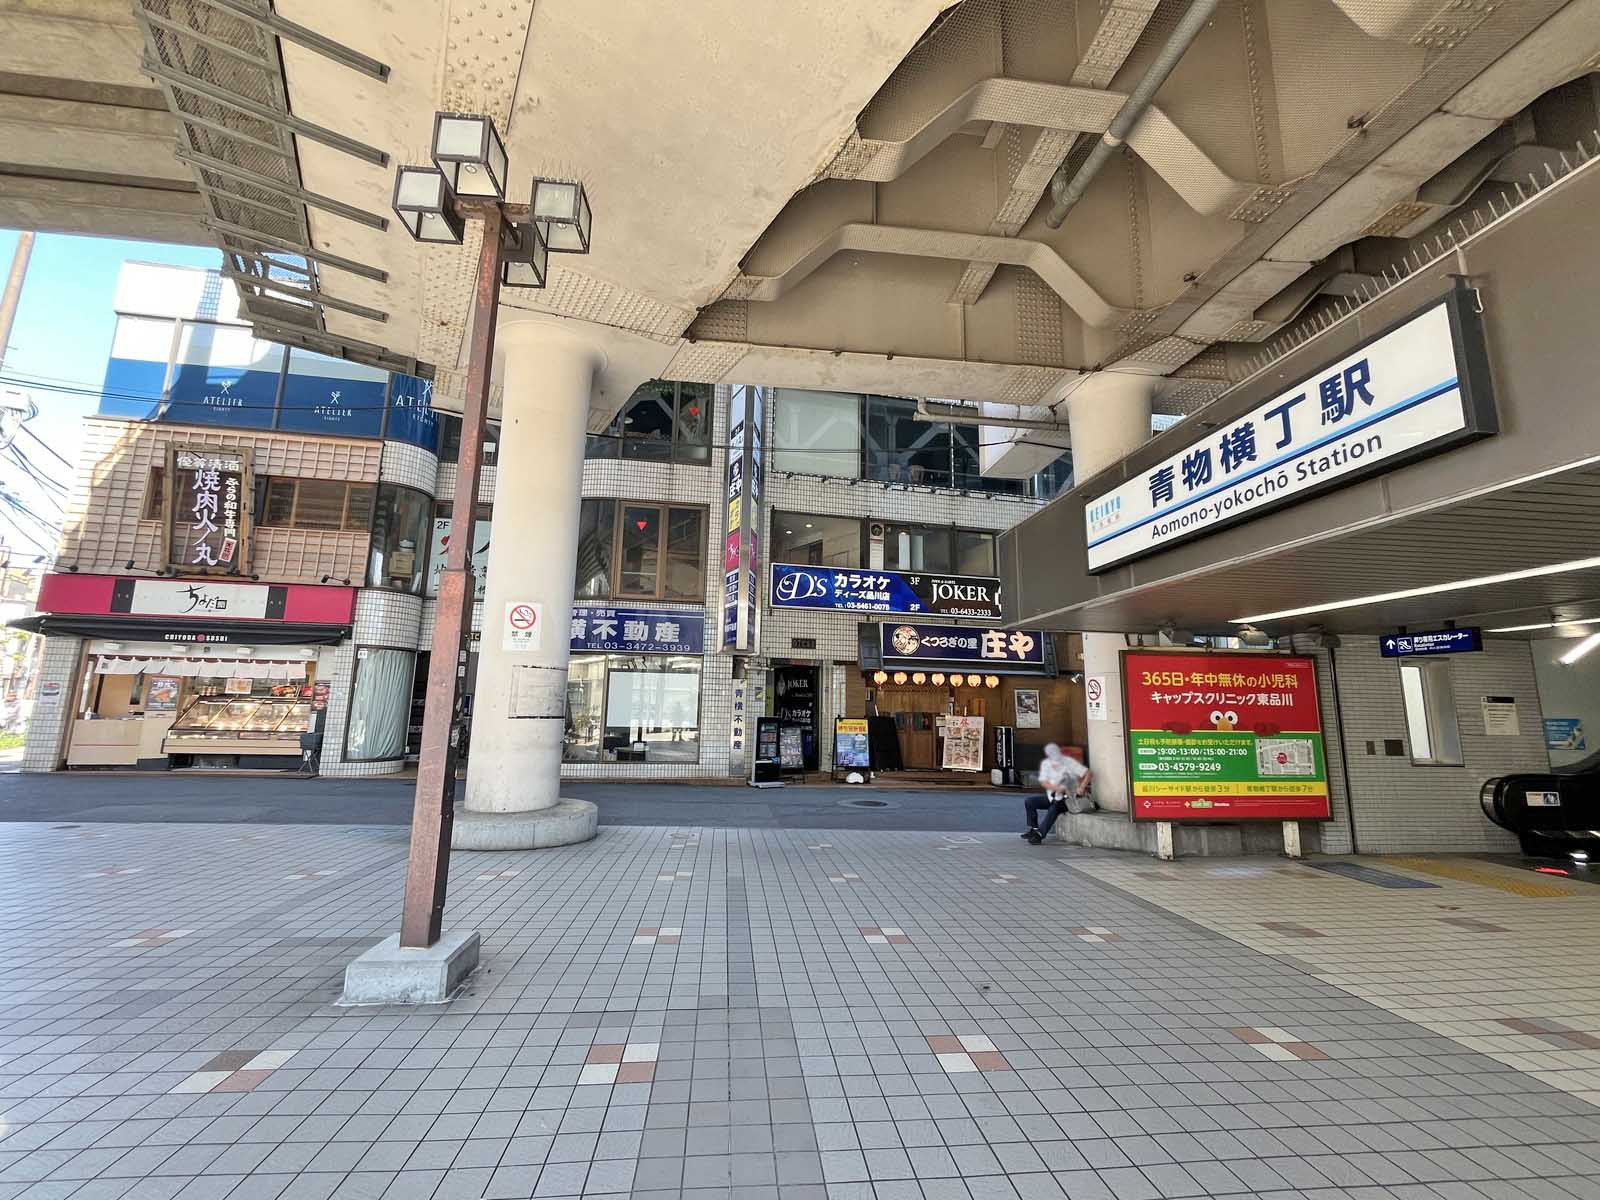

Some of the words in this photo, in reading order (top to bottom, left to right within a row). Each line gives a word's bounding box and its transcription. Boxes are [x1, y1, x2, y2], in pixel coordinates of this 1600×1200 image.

[203, 396, 243, 407] ATELIER
[314, 406, 352, 416] ATELIER
[1148, 358, 1375, 508] 青物横丁駅
[1151, 471, 1288, 540] Aomono-yokochō
[1295, 434, 1383, 481] Station
[192, 469, 220, 566] 焼肉火ノ丸
[436, 521, 450, 529] 2F
[834, 574, 891, 590] カラオケ
[910, 577, 920, 585] 3F
[931, 584, 991, 604] JOKER
[950, 608, 992, 616] 03-6433-2333
[604, 642, 690, 651] 03-3472-3939
[920, 636, 978, 649] くつろぎの里
[981, 630, 1034, 660] 庄や
[787, 680, 808, 689] JOKER
[1142, 671, 1298, 688] 365日・年中無休の小児科
[1151, 691, 1293, 706] キャップスクリニック東品川
[792, 709, 811, 718] カラオケ
